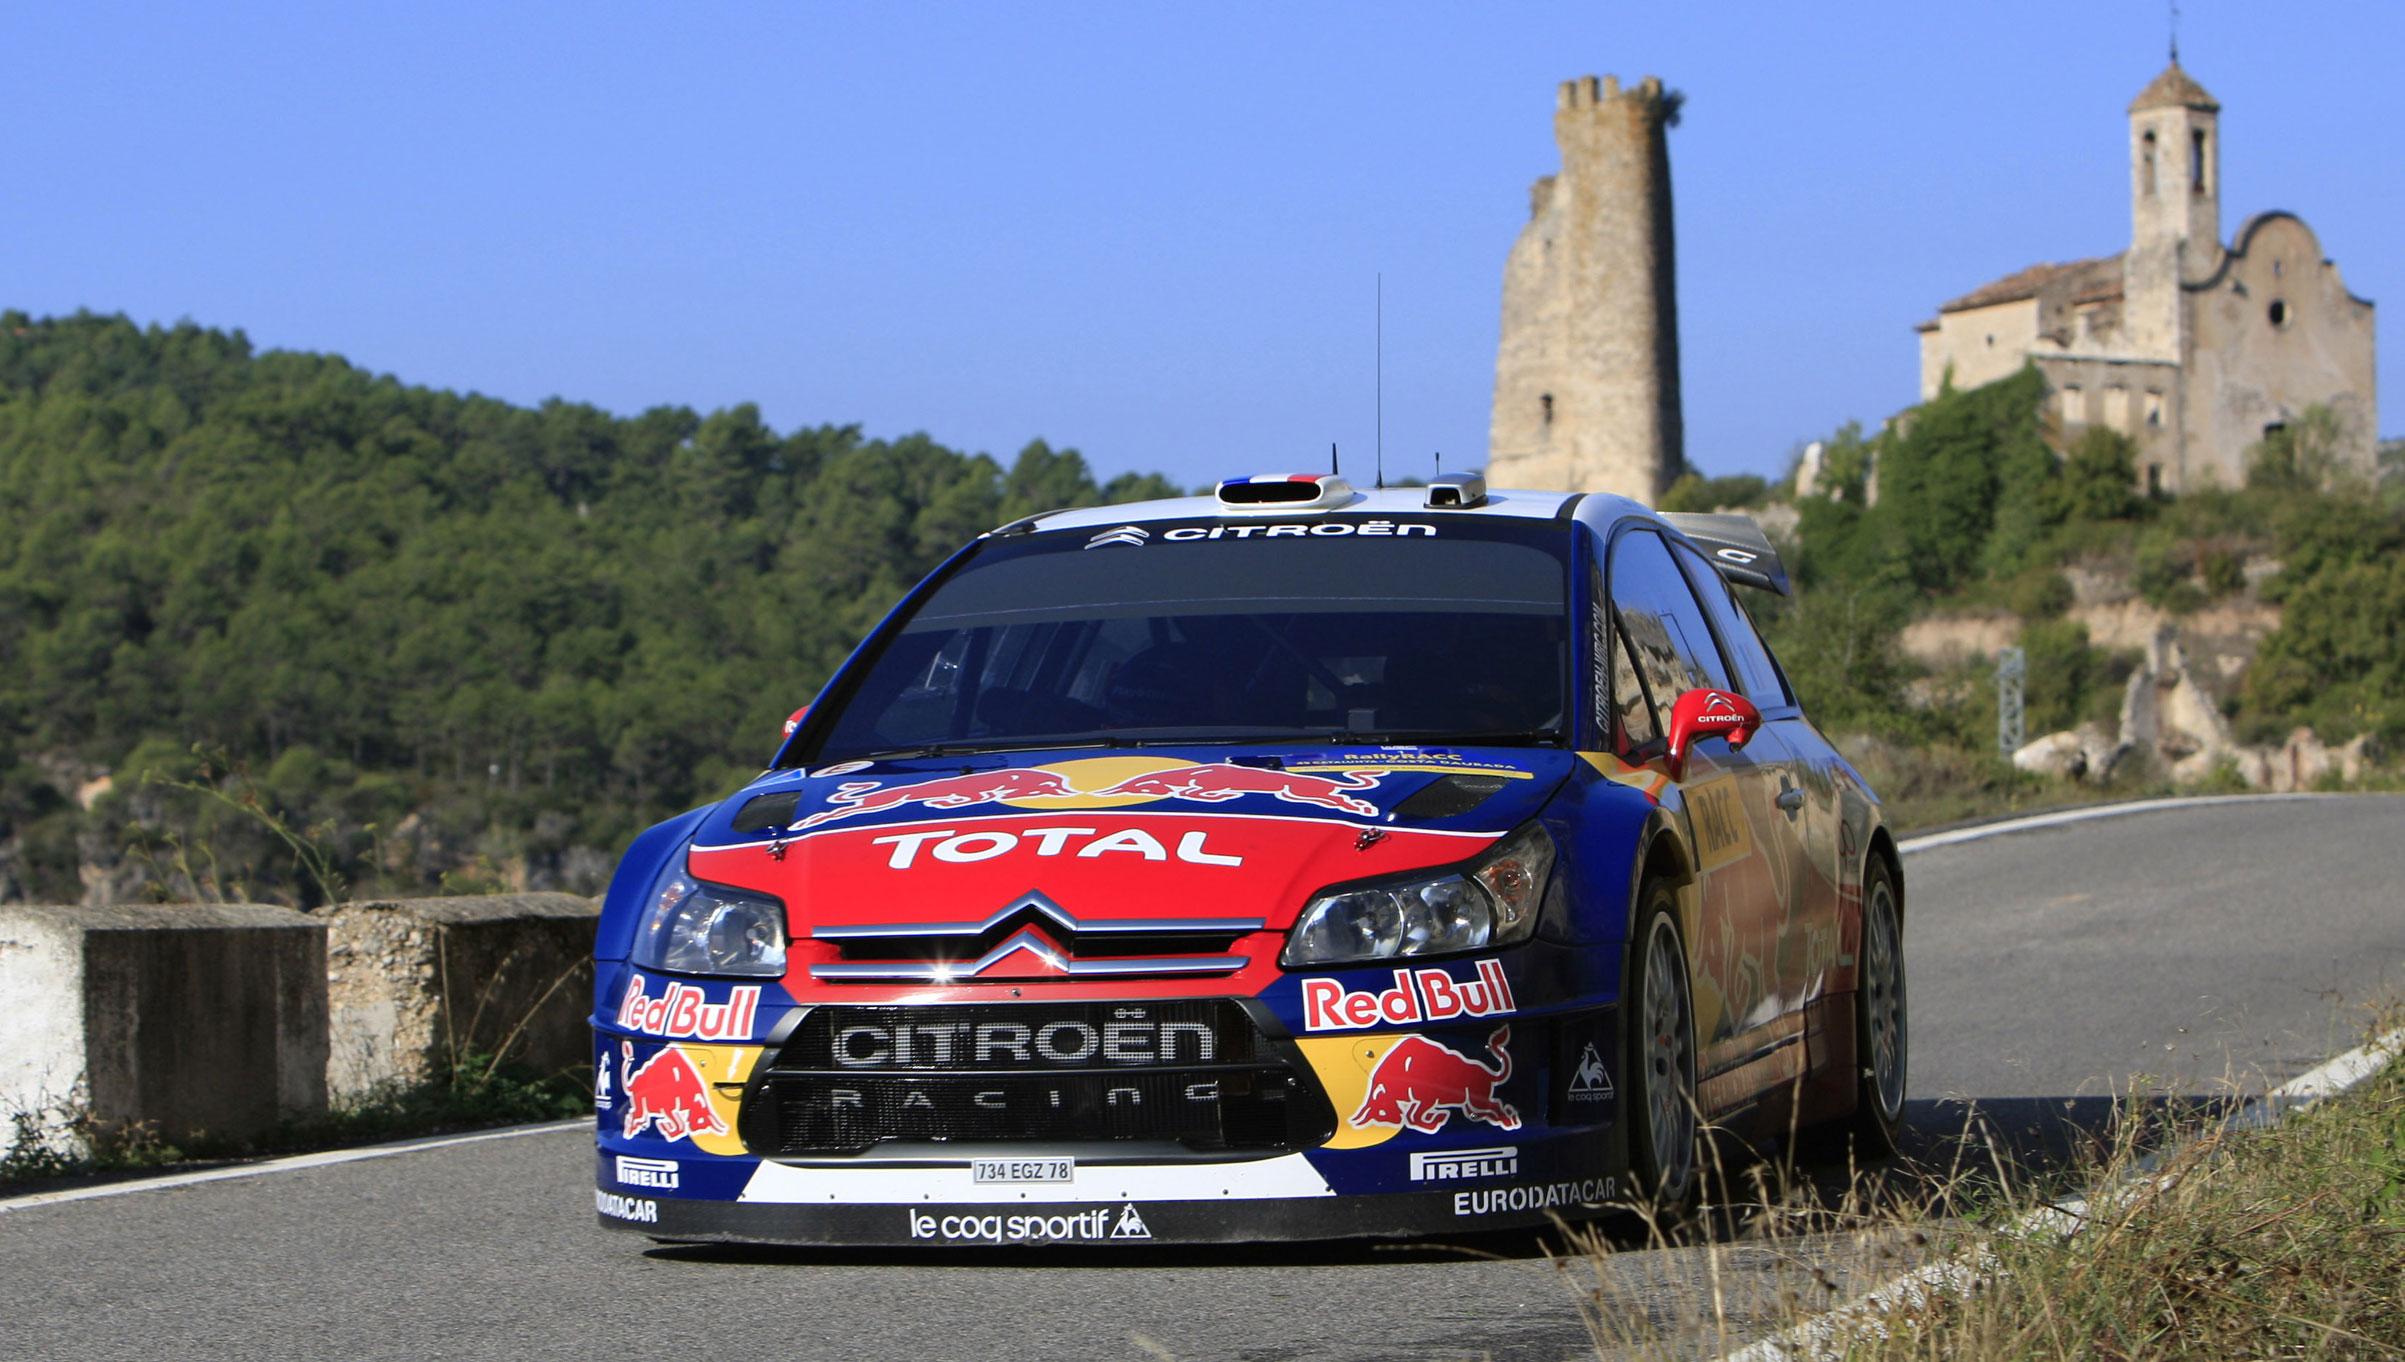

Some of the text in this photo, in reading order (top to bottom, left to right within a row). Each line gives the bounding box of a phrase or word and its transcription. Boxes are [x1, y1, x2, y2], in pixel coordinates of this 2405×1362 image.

[1163, 520, 1437, 541] CITROËN
[1697, 713, 1745, 723] CITROËN
[1344, 753, 1462, 762] RallyRACC
[873, 827, 1243, 869] TOTAL
[617, 975, 761, 1041] Red Bull
[1302, 958, 1516, 1031] Red Bull
[831, 1008, 1213, 1066] CITROËN
[615, 1155, 679, 1189] PIRELLI
[978, 1161, 1069, 1180] 734 EGZ 78
[1410, 1147, 1518, 1182] PIRELLI
[1454, 1177, 1616, 1216] EURODATACAR
[910, 1208, 1109, 1243] le coq sportif
